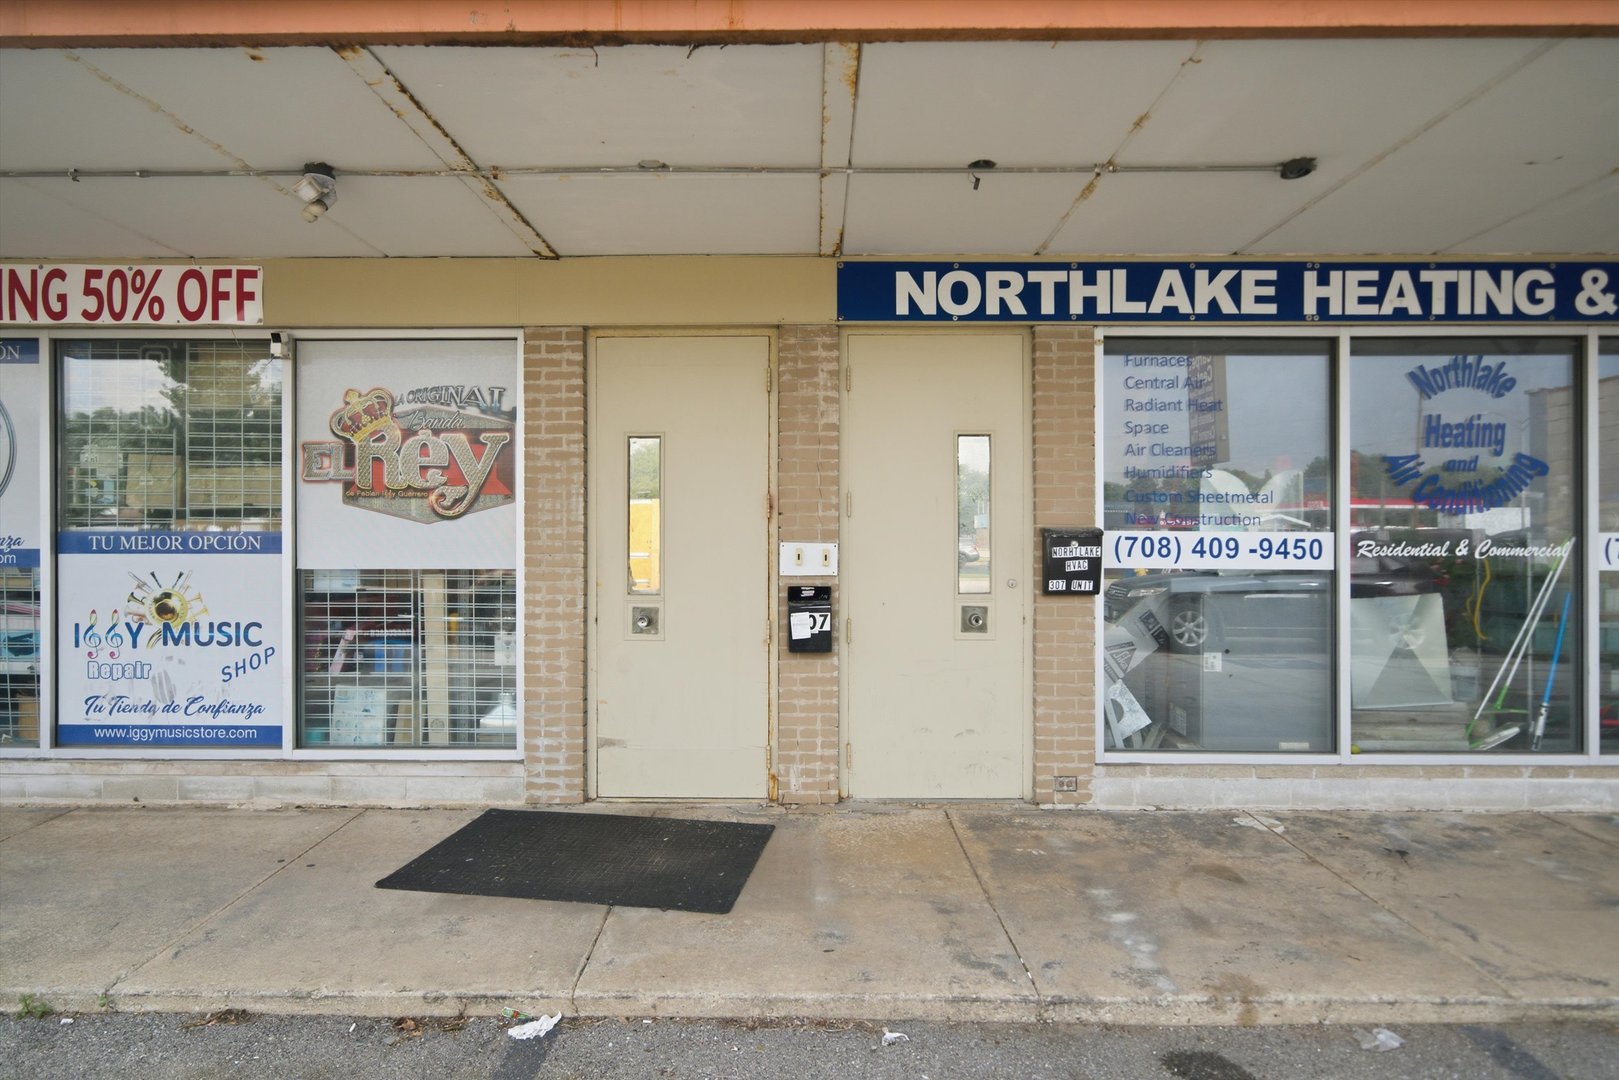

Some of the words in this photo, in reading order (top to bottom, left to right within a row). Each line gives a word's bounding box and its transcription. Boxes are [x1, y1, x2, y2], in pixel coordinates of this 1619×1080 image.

[0, 268, 68, 321] NG
[80, 269, 165, 322] 50%
[176, 268, 258, 322] OFF
[895, 268, 1278, 315] NORTHLAKE
[1303, 269, 1556, 316] HEATING
[1574, 269, 1618, 316] &
[1123, 353, 1193, 367] Furnaces
[1124, 375, 1180, 389] Central
[1183, 375, 1206, 389] Air
[1405, 354, 1517, 400] Northlake
[1124, 398, 1183, 412] Radiant
[1188, 398, 1223, 412] Heat
[406, 410, 466, 431] Banda
[1123, 420, 1169, 434] Space
[1423, 413, 1506, 457] Heating
[1123, 443, 1146, 457] Air
[1150, 443, 1217, 457] Cleaners
[353, 428, 510, 517] Rey
[1123, 465, 1213, 479] Humidifiers
[1442, 455, 1480, 473] and
[1382, 453, 1425, 487] Air
[1410, 451, 1550, 516] Conditioning
[1124, 489, 1183, 504] Custom
[1187, 489, 1274, 504] Sheetmetal
[1124, 512, 1161, 526] New
[1163, 512, 1262, 526] Construction
[88, 535, 115, 551] TU
[119, 535, 184, 551] MEJOR
[188, 532, 262, 551] OPCIÓN
[1113, 535, 1182, 564] (708)
[1191, 536, 1241, 559] 409
[1248, 537, 1324, 560] -9450
[1356, 539, 1449, 558] Residential
[1454, 538, 1469, 557] &
[1474, 538, 1571, 559] Commercial
[1066, 560, 1088, 571] HVAC
[1049, 580, 1065, 590] 307
[1071, 580, 1093, 590] UNIT
[162, 621, 263, 647] MUSIC
[87, 660, 152, 681] Repair
[221, 646, 276, 683] SHOP
[84, 695, 105, 716] Tu
[108, 695, 160, 717] Tienda
[162, 699, 183, 714] de
[184, 695, 266, 720] Confianza
[94, 725, 257, 741] www.iggymusicstore.com
